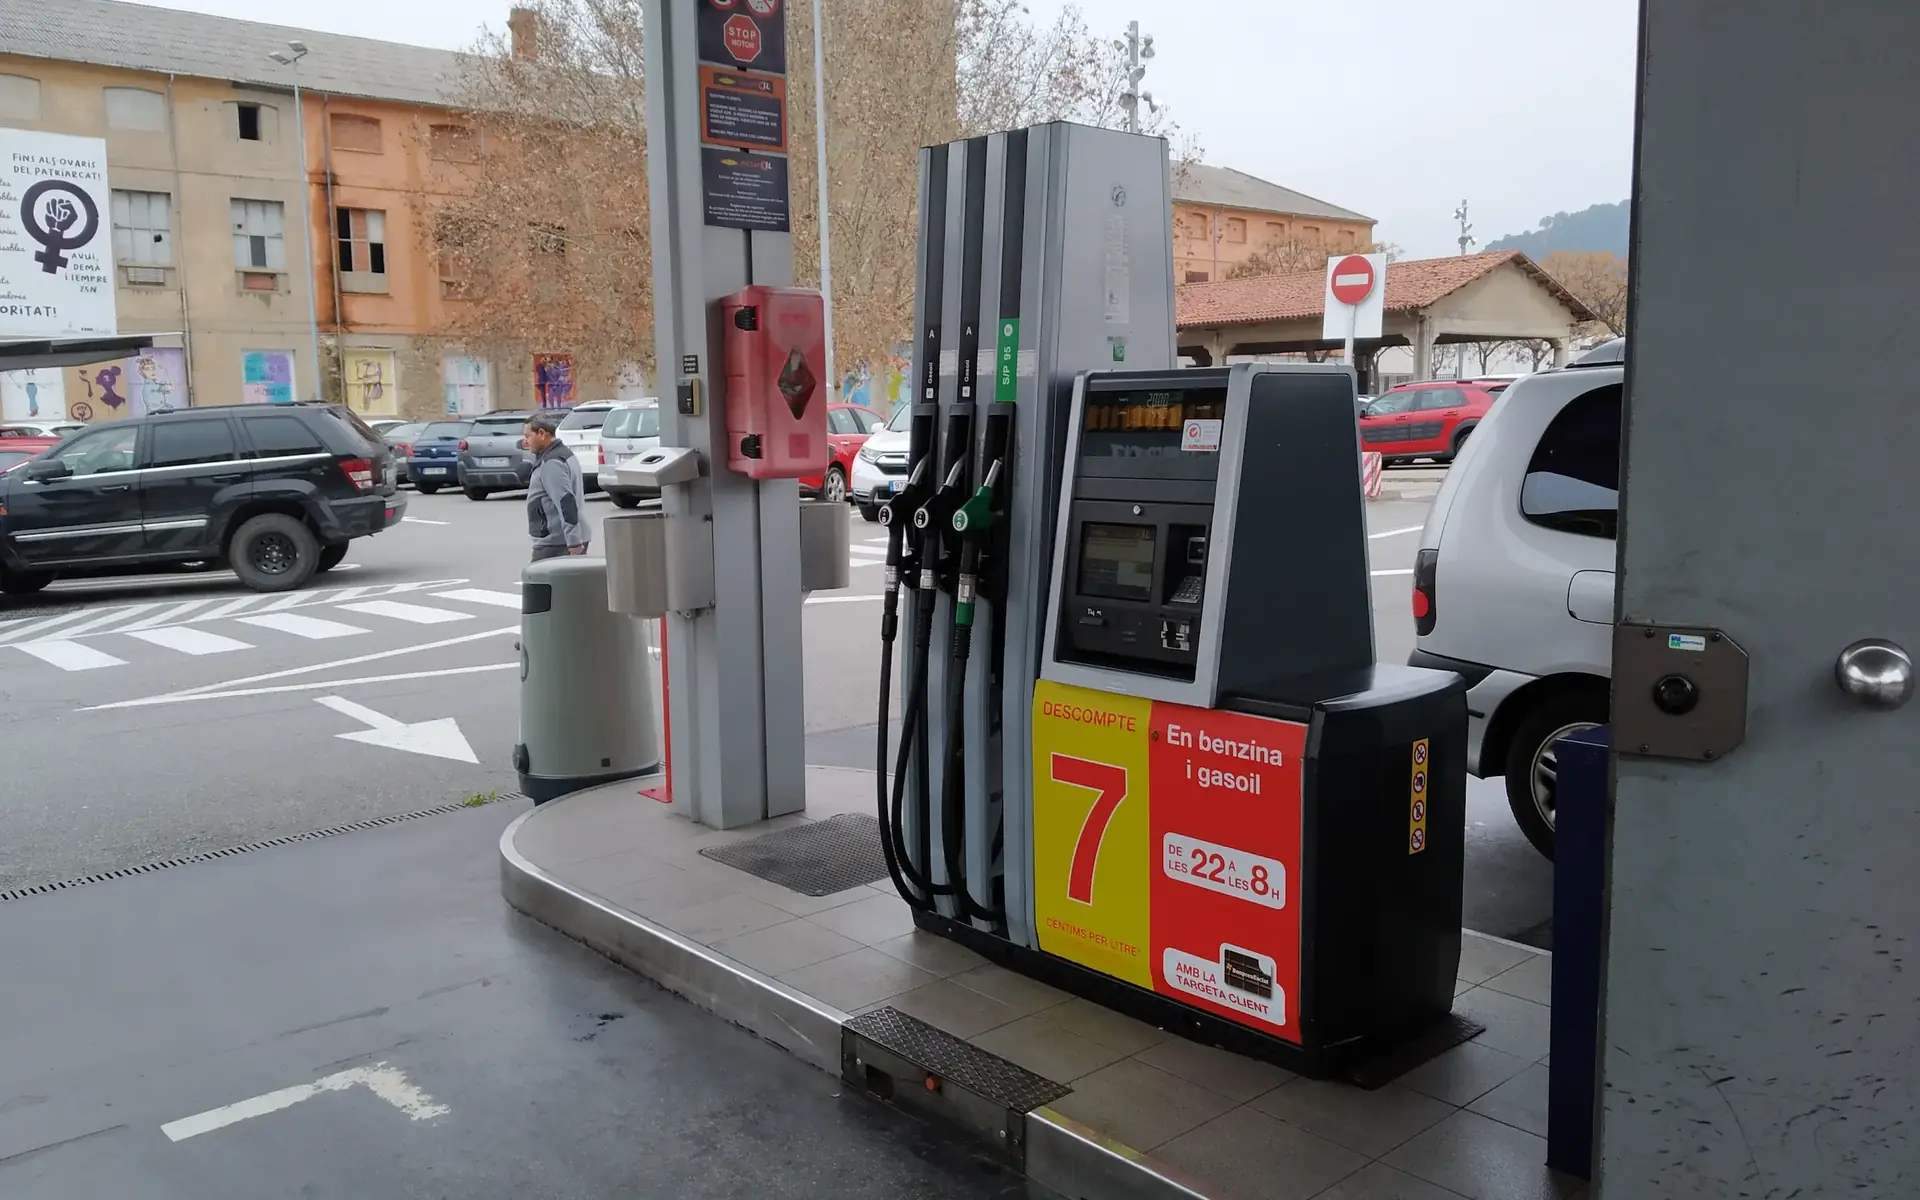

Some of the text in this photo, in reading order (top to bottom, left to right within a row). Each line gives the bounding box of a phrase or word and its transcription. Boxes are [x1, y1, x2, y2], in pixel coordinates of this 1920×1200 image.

[728, 26, 756, 40] STOP
[732, 39, 754, 48] MOTOR
[14, 166, 31, 174] DEL
[39, 156, 56, 166] ALS
[0, 305, 56, 318] ORiTAT!
[929, 330, 935, 338] A
[966, 326, 972, 335] A
[1002, 346, 1011, 385] S/P 95
[1043, 701, 1136, 732] DESCOMPTE
[1167, 723, 1282, 766] En benzina
[1186, 759, 1260, 795] i gasoil
[1050, 752, 1128, 906] 7
[1168, 844, 1280, 900] DE LES 22 A LES 8 H
[1046, 917, 1086, 939] CENTIMS
[1089, 932, 1107, 946] PER
[1176, 962, 1216, 984] AMB LA
[1176, 974, 1268, 1014] TARGETA CLIENT
